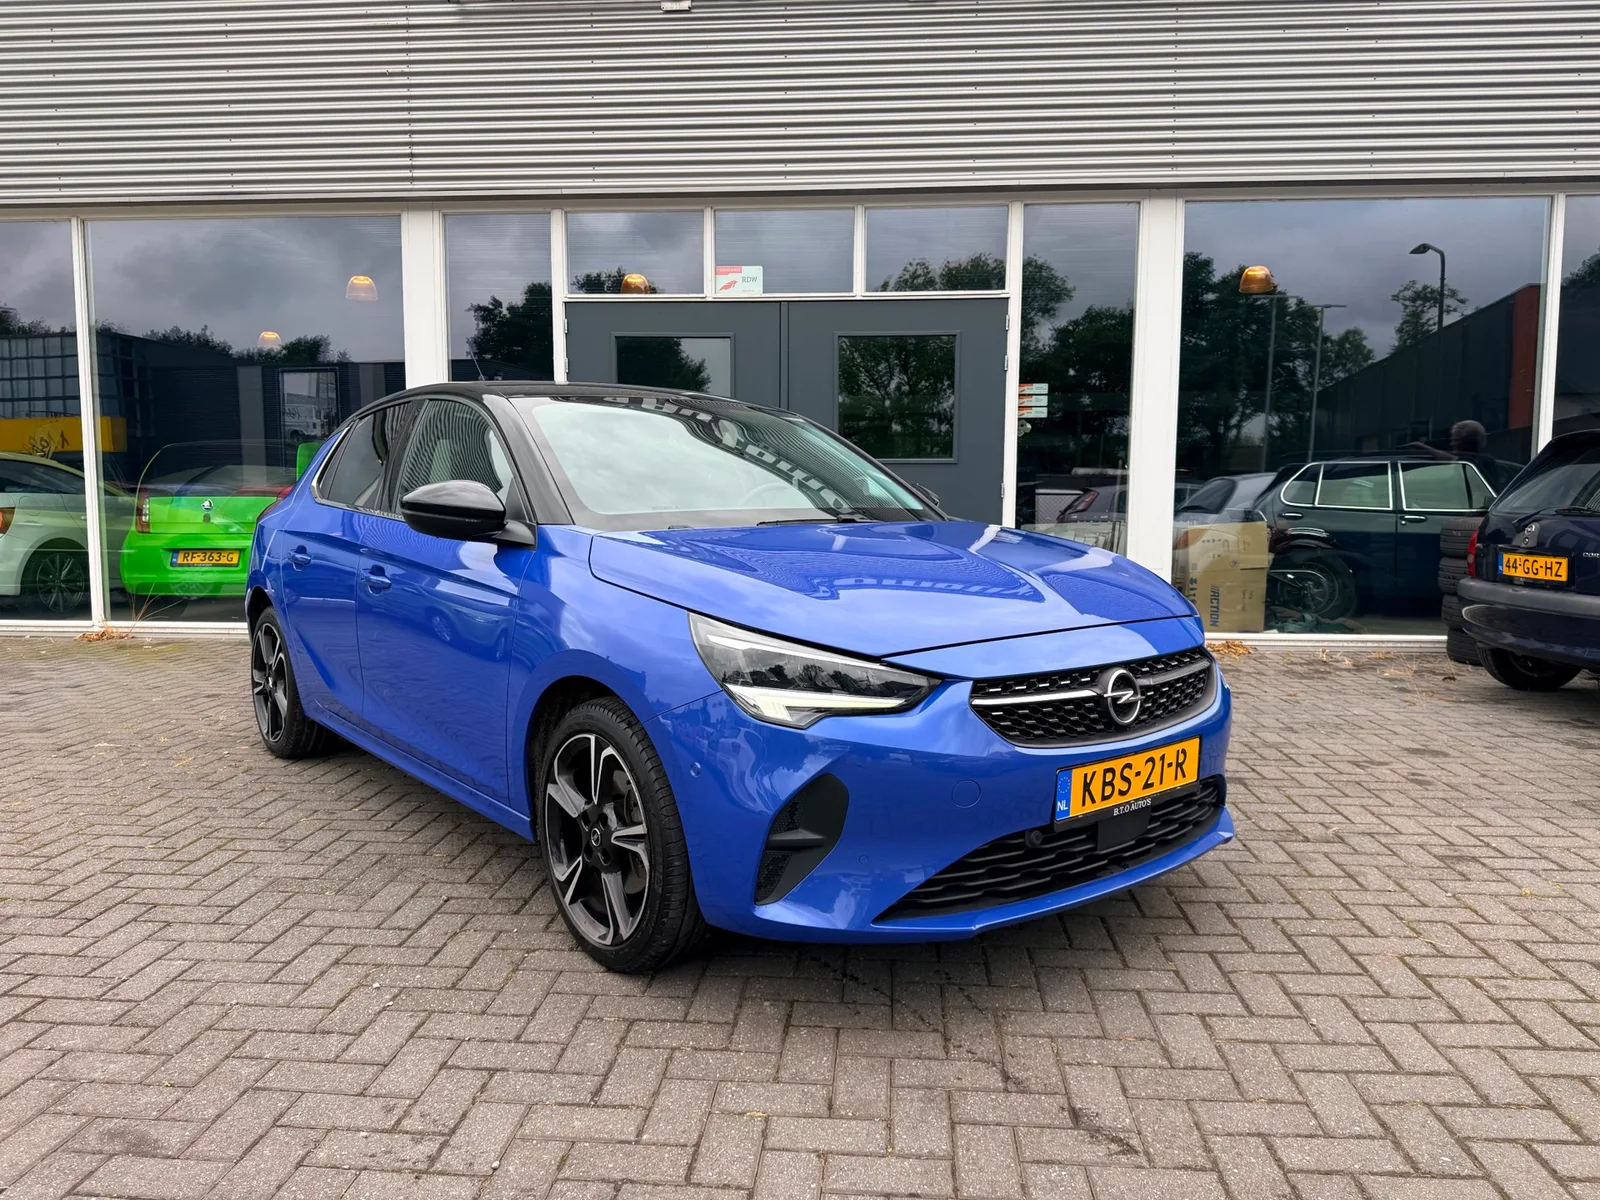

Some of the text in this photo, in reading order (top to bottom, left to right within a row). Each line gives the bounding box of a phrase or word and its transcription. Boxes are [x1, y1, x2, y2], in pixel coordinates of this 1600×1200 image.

[182, 551, 234, 562] RF-363-G
[1081, 747, 1188, 808] KBS-21-R
[1056, 800, 1069, 812] NL
